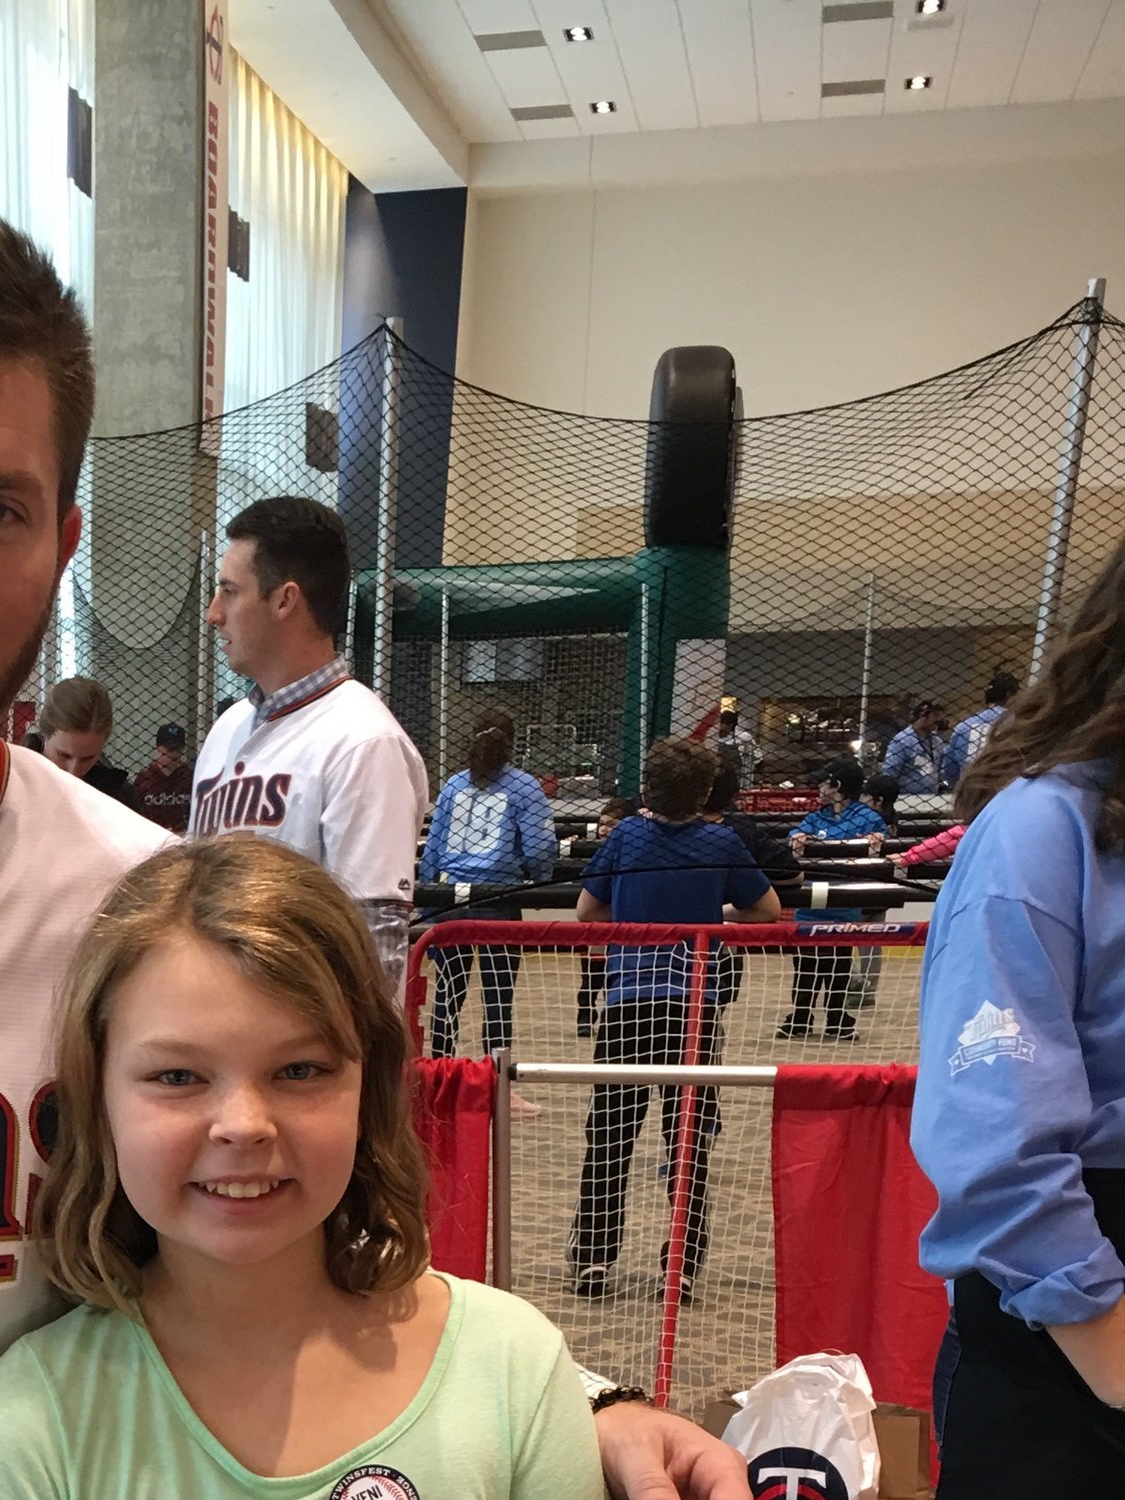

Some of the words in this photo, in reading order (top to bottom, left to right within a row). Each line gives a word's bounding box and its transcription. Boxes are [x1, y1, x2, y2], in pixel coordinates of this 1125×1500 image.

[196, 760, 293, 840] Twins
[809, 922, 901, 937] PRIMED
[332, 1467, 392, 1500] TWINSFEST
